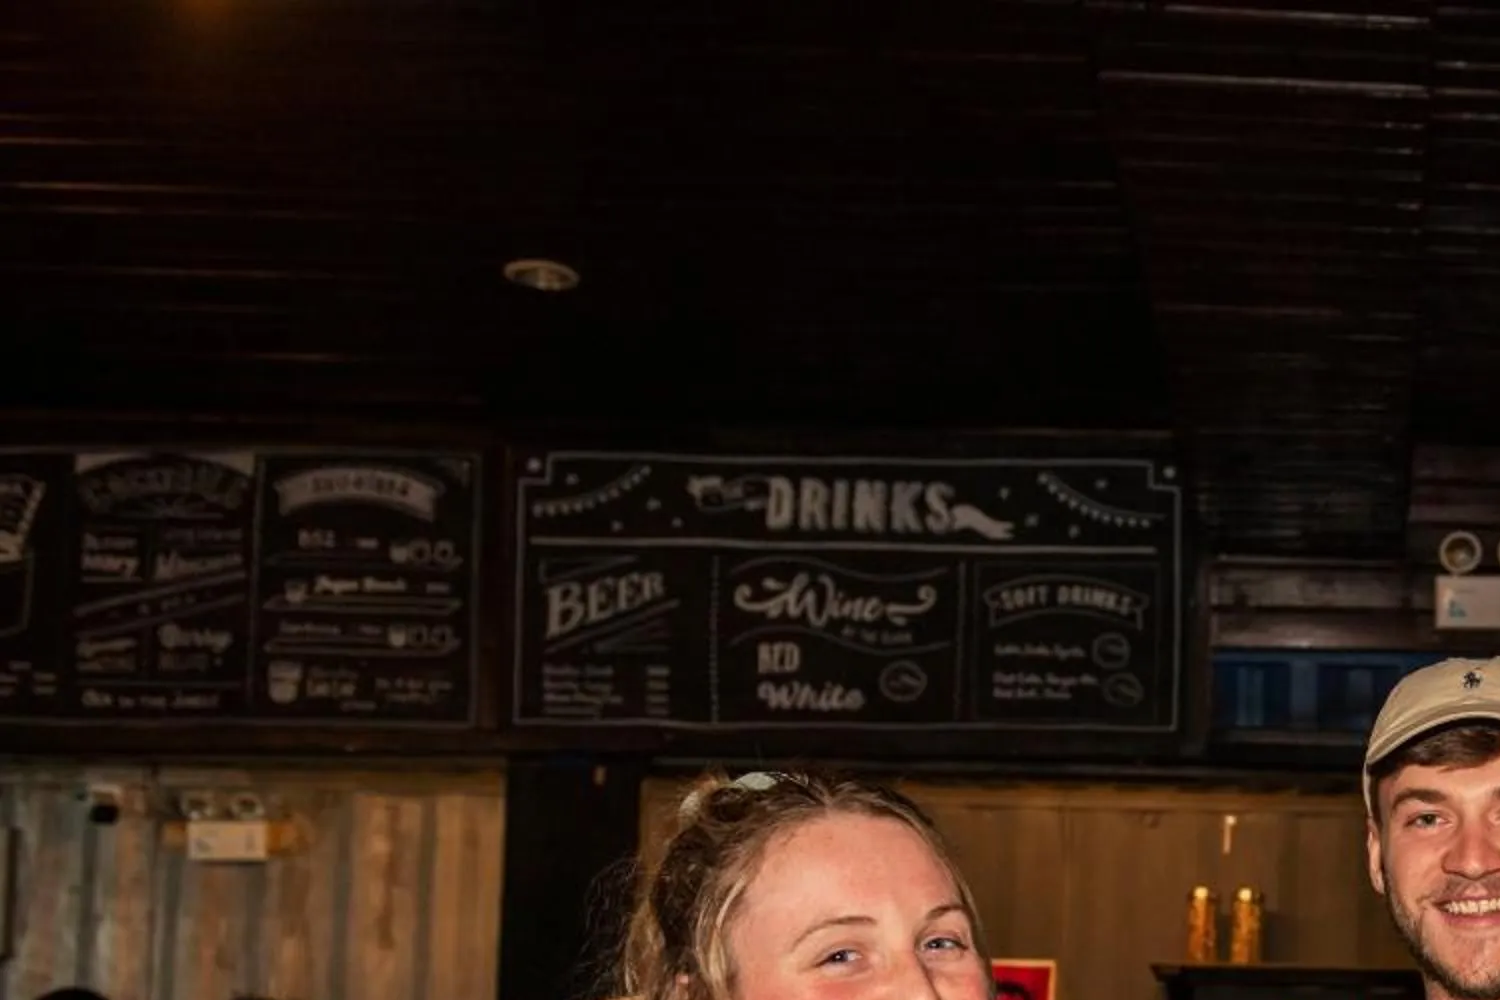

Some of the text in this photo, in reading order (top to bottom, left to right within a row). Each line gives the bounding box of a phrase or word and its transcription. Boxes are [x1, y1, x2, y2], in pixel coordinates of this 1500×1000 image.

[765, 475, 957, 534] DRINKS
[545, 571, 667, 640] BEER
[733, 570, 887, 629] Wine
[757, 641, 801, 675] RED
[757, 679, 867, 713] White
